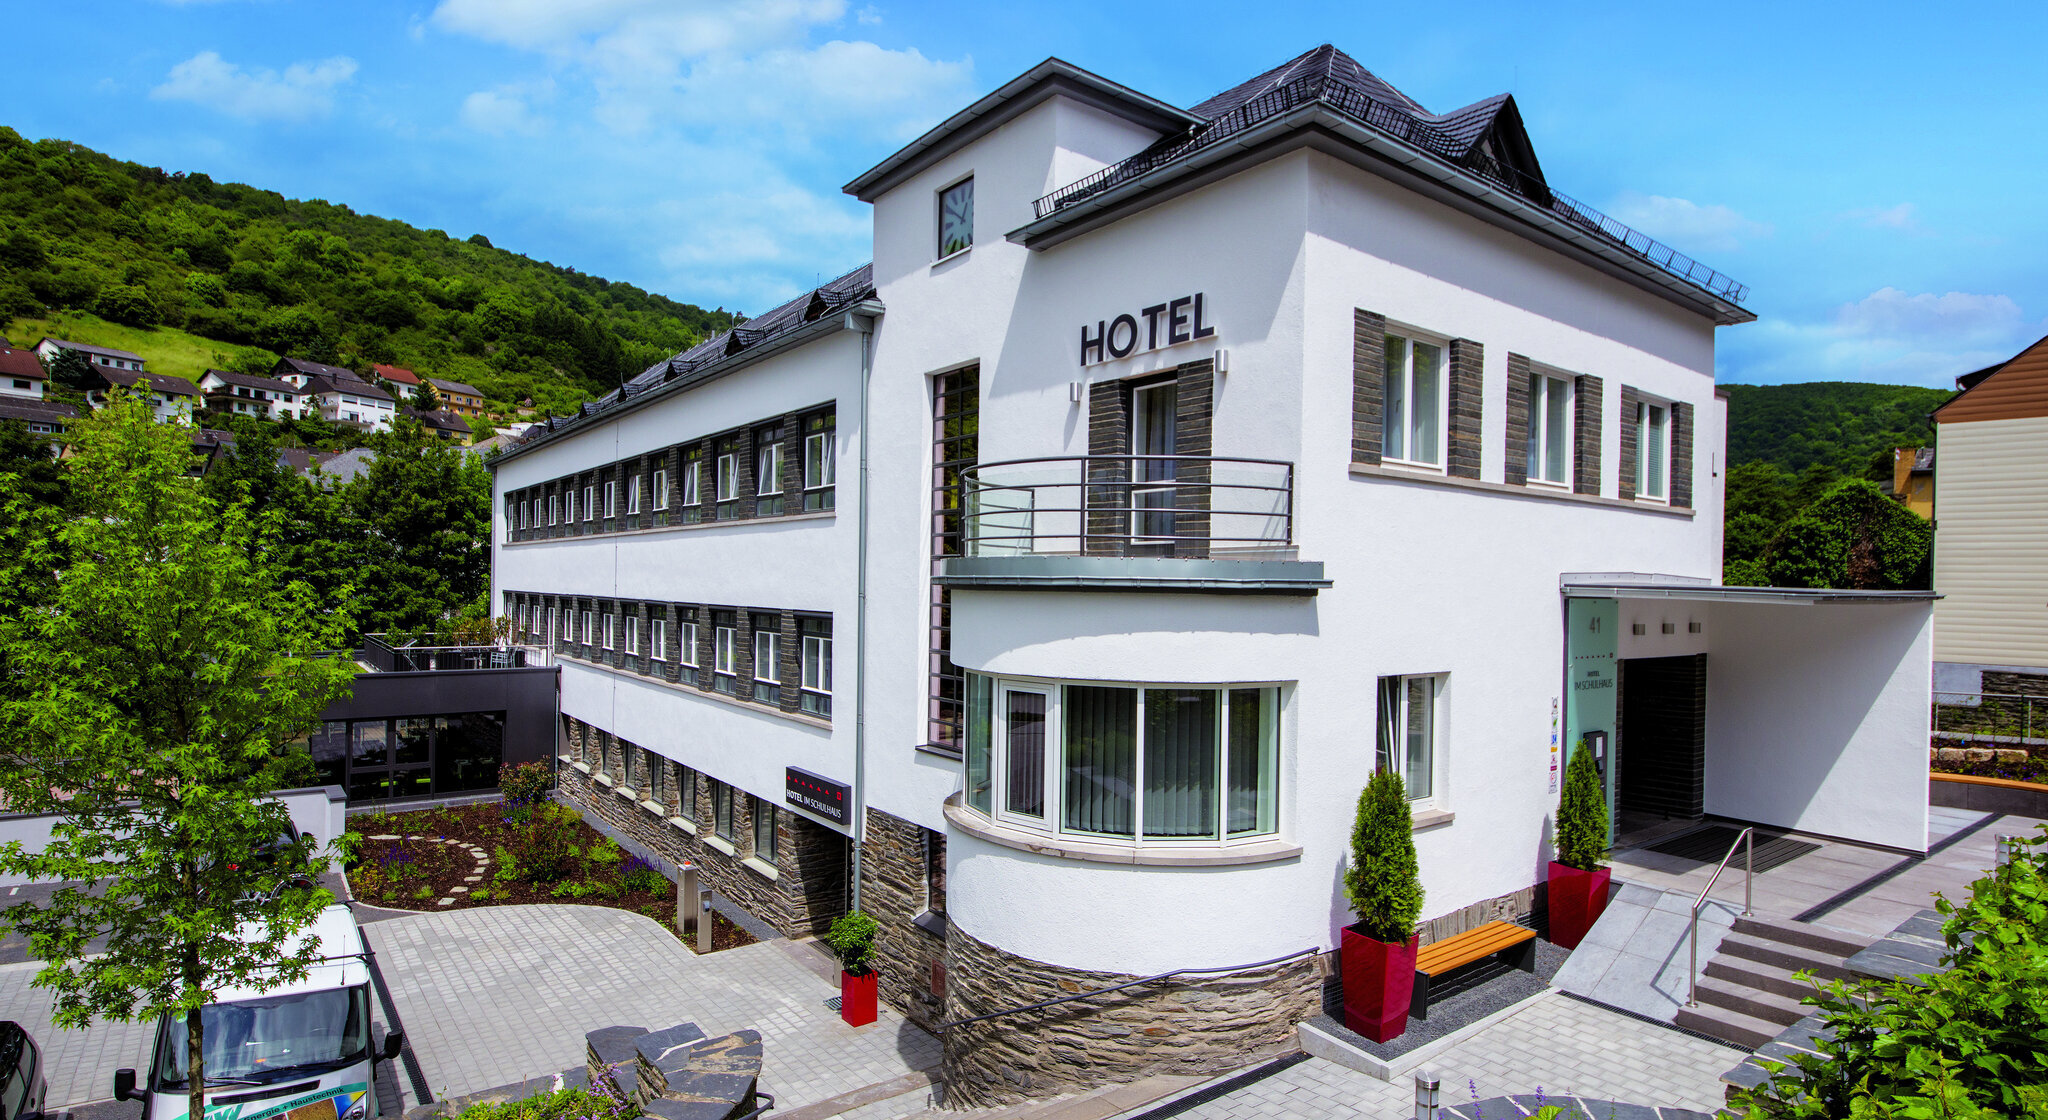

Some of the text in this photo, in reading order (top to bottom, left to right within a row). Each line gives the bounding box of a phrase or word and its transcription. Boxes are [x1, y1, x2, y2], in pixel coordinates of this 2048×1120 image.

[1080, 292, 1216, 367] HOTEL
[1589, 616, 1600, 633] 41
[1575, 679, 1613, 690] IM SCHULHAUS
[786, 789, 841, 818] HOTEL IM SCHULHAUS
[290, 1088, 344, 1107] Haustechnik
